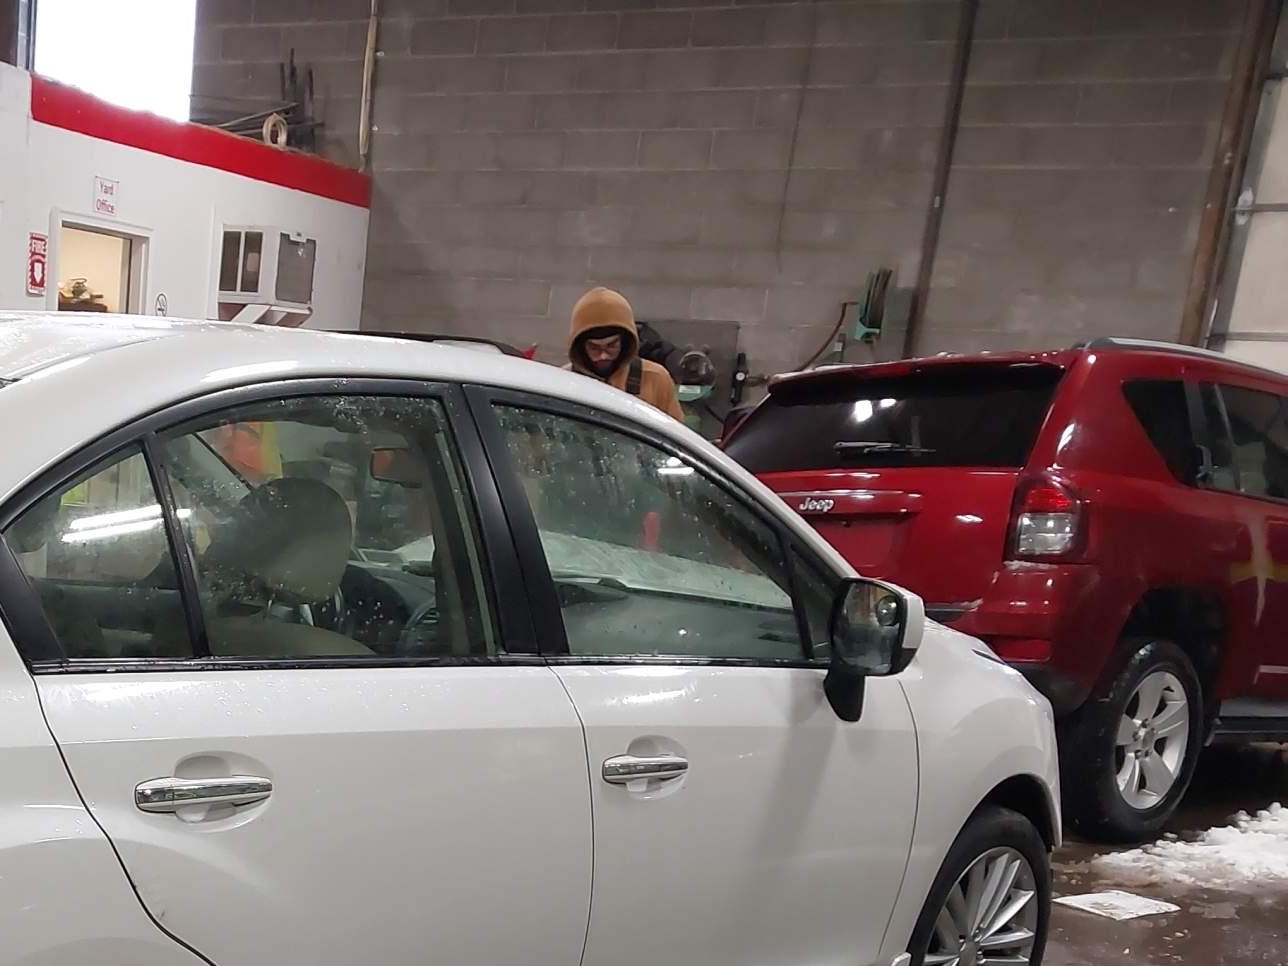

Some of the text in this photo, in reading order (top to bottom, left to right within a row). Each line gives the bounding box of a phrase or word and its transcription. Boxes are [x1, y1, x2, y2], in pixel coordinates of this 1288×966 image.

[99, 181, 114, 196] Yard
[96, 198, 115, 214] Office
[799, 497, 835, 513] Jeep
